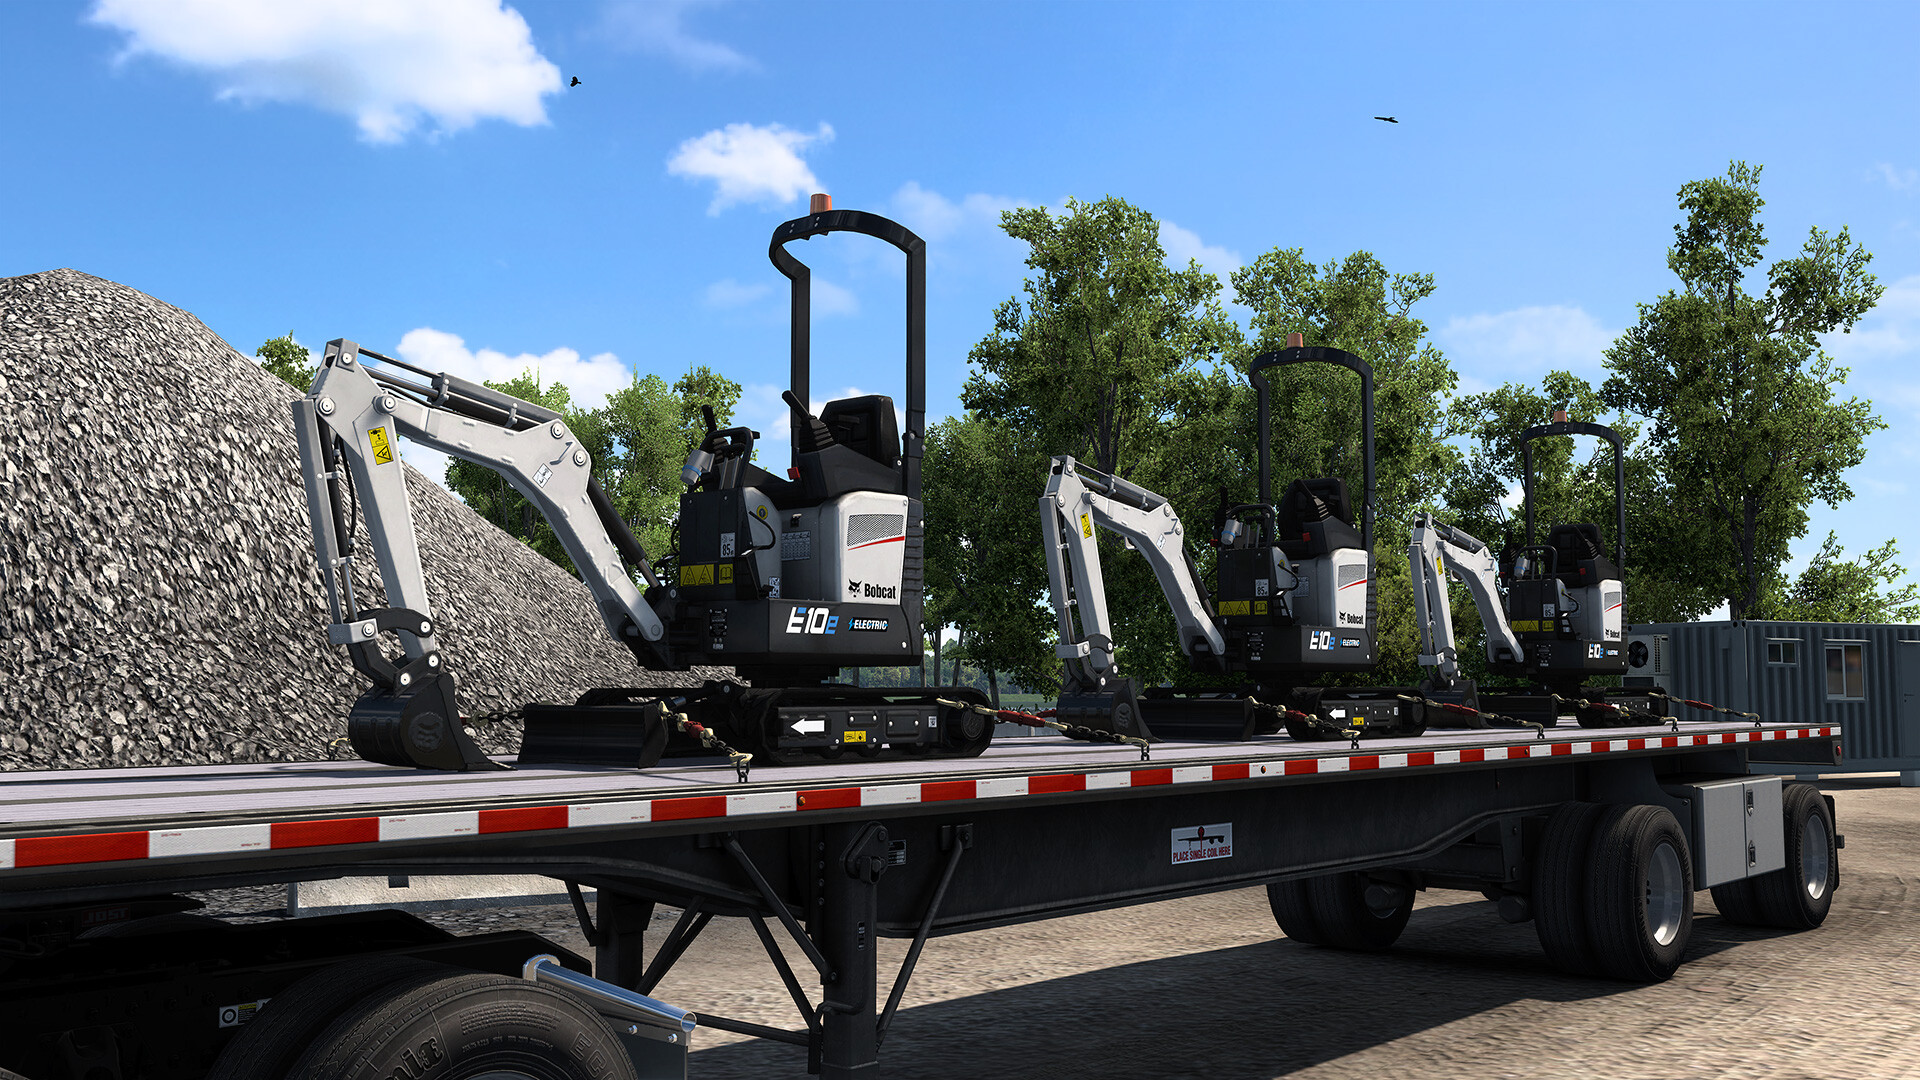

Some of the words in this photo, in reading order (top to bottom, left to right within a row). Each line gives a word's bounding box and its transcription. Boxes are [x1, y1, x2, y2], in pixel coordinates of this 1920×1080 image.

[722, 543, 731, 556] 85
[864, 583, 896, 599] Bobcat
[786, 606, 840, 635] E10e
[853, 618, 888, 630] ELECTRIC
[1347, 613, 1364, 625] Bobcat
[1309, 630, 1336, 650] E10e
[1588, 643, 1604, 659] E10e
[1173, 851, 1189, 862] PLACE
[1189, 848, 1206, 861] SINGLE
[1207, 847, 1218, 858] COIL
[1219, 846, 1231, 856] HERE
[84, 907, 128, 923] JOST
